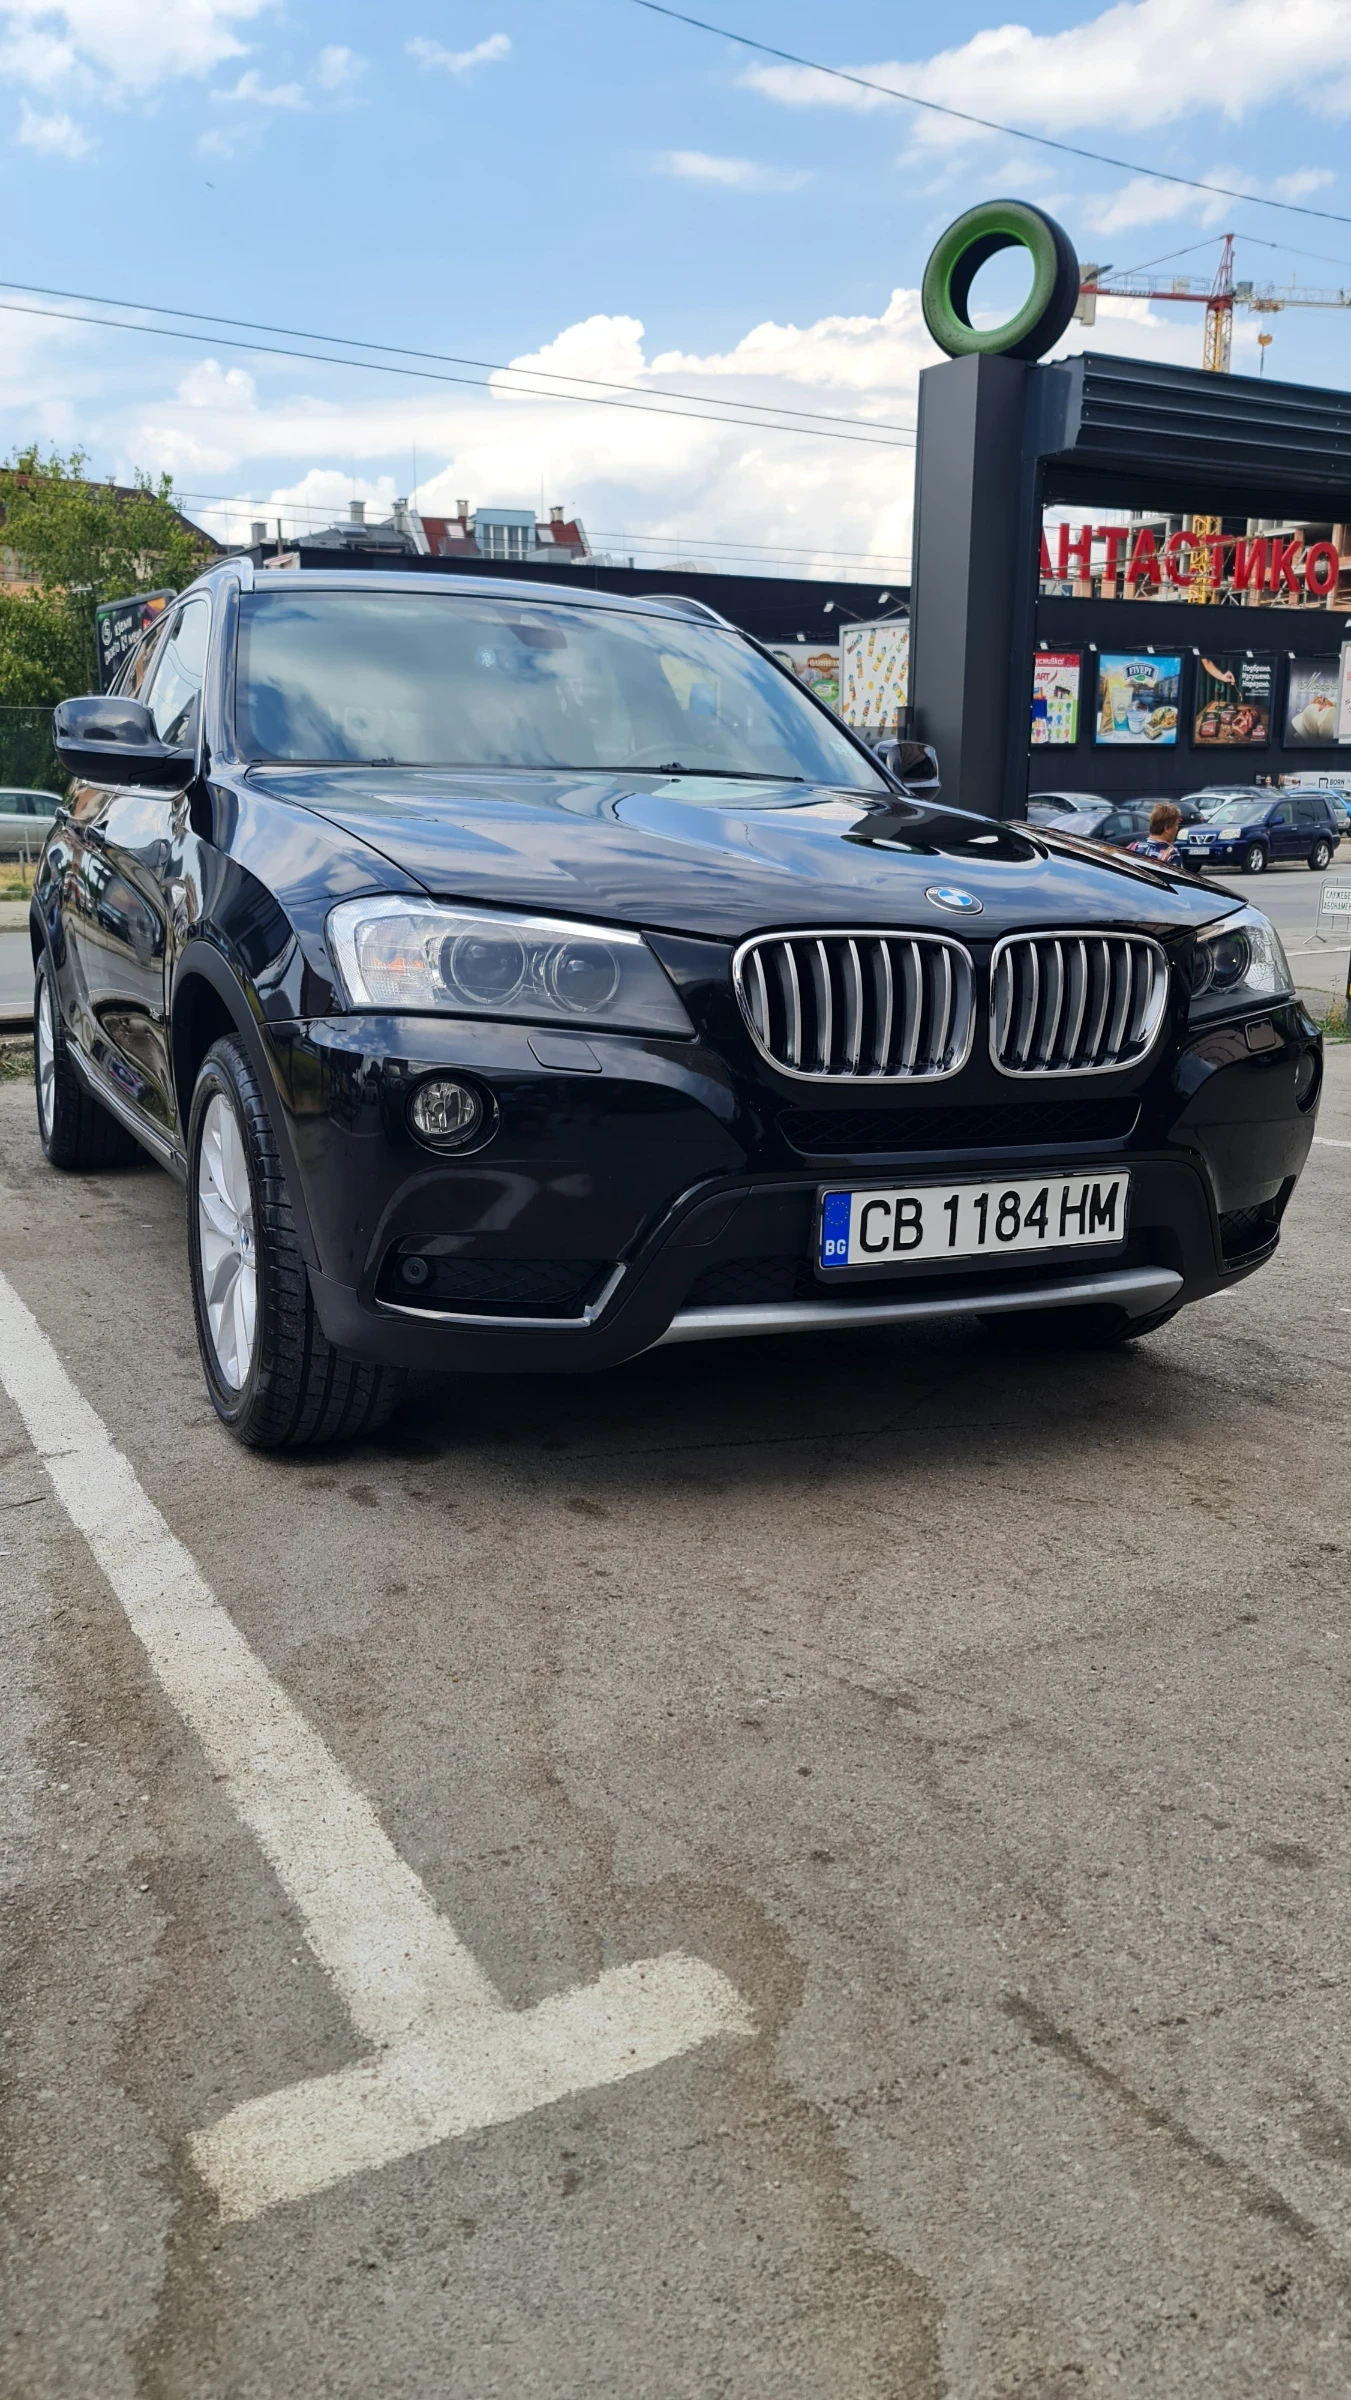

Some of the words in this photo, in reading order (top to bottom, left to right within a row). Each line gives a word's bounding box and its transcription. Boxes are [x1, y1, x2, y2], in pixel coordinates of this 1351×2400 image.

[1329, 778, 1345, 786] BORN
[859, 1197, 924, 1253] CB
[943, 1187, 1049, 1248] 1184
[1058, 1181, 1120, 1237] HM
[825, 1238, 847, 1256] BG
